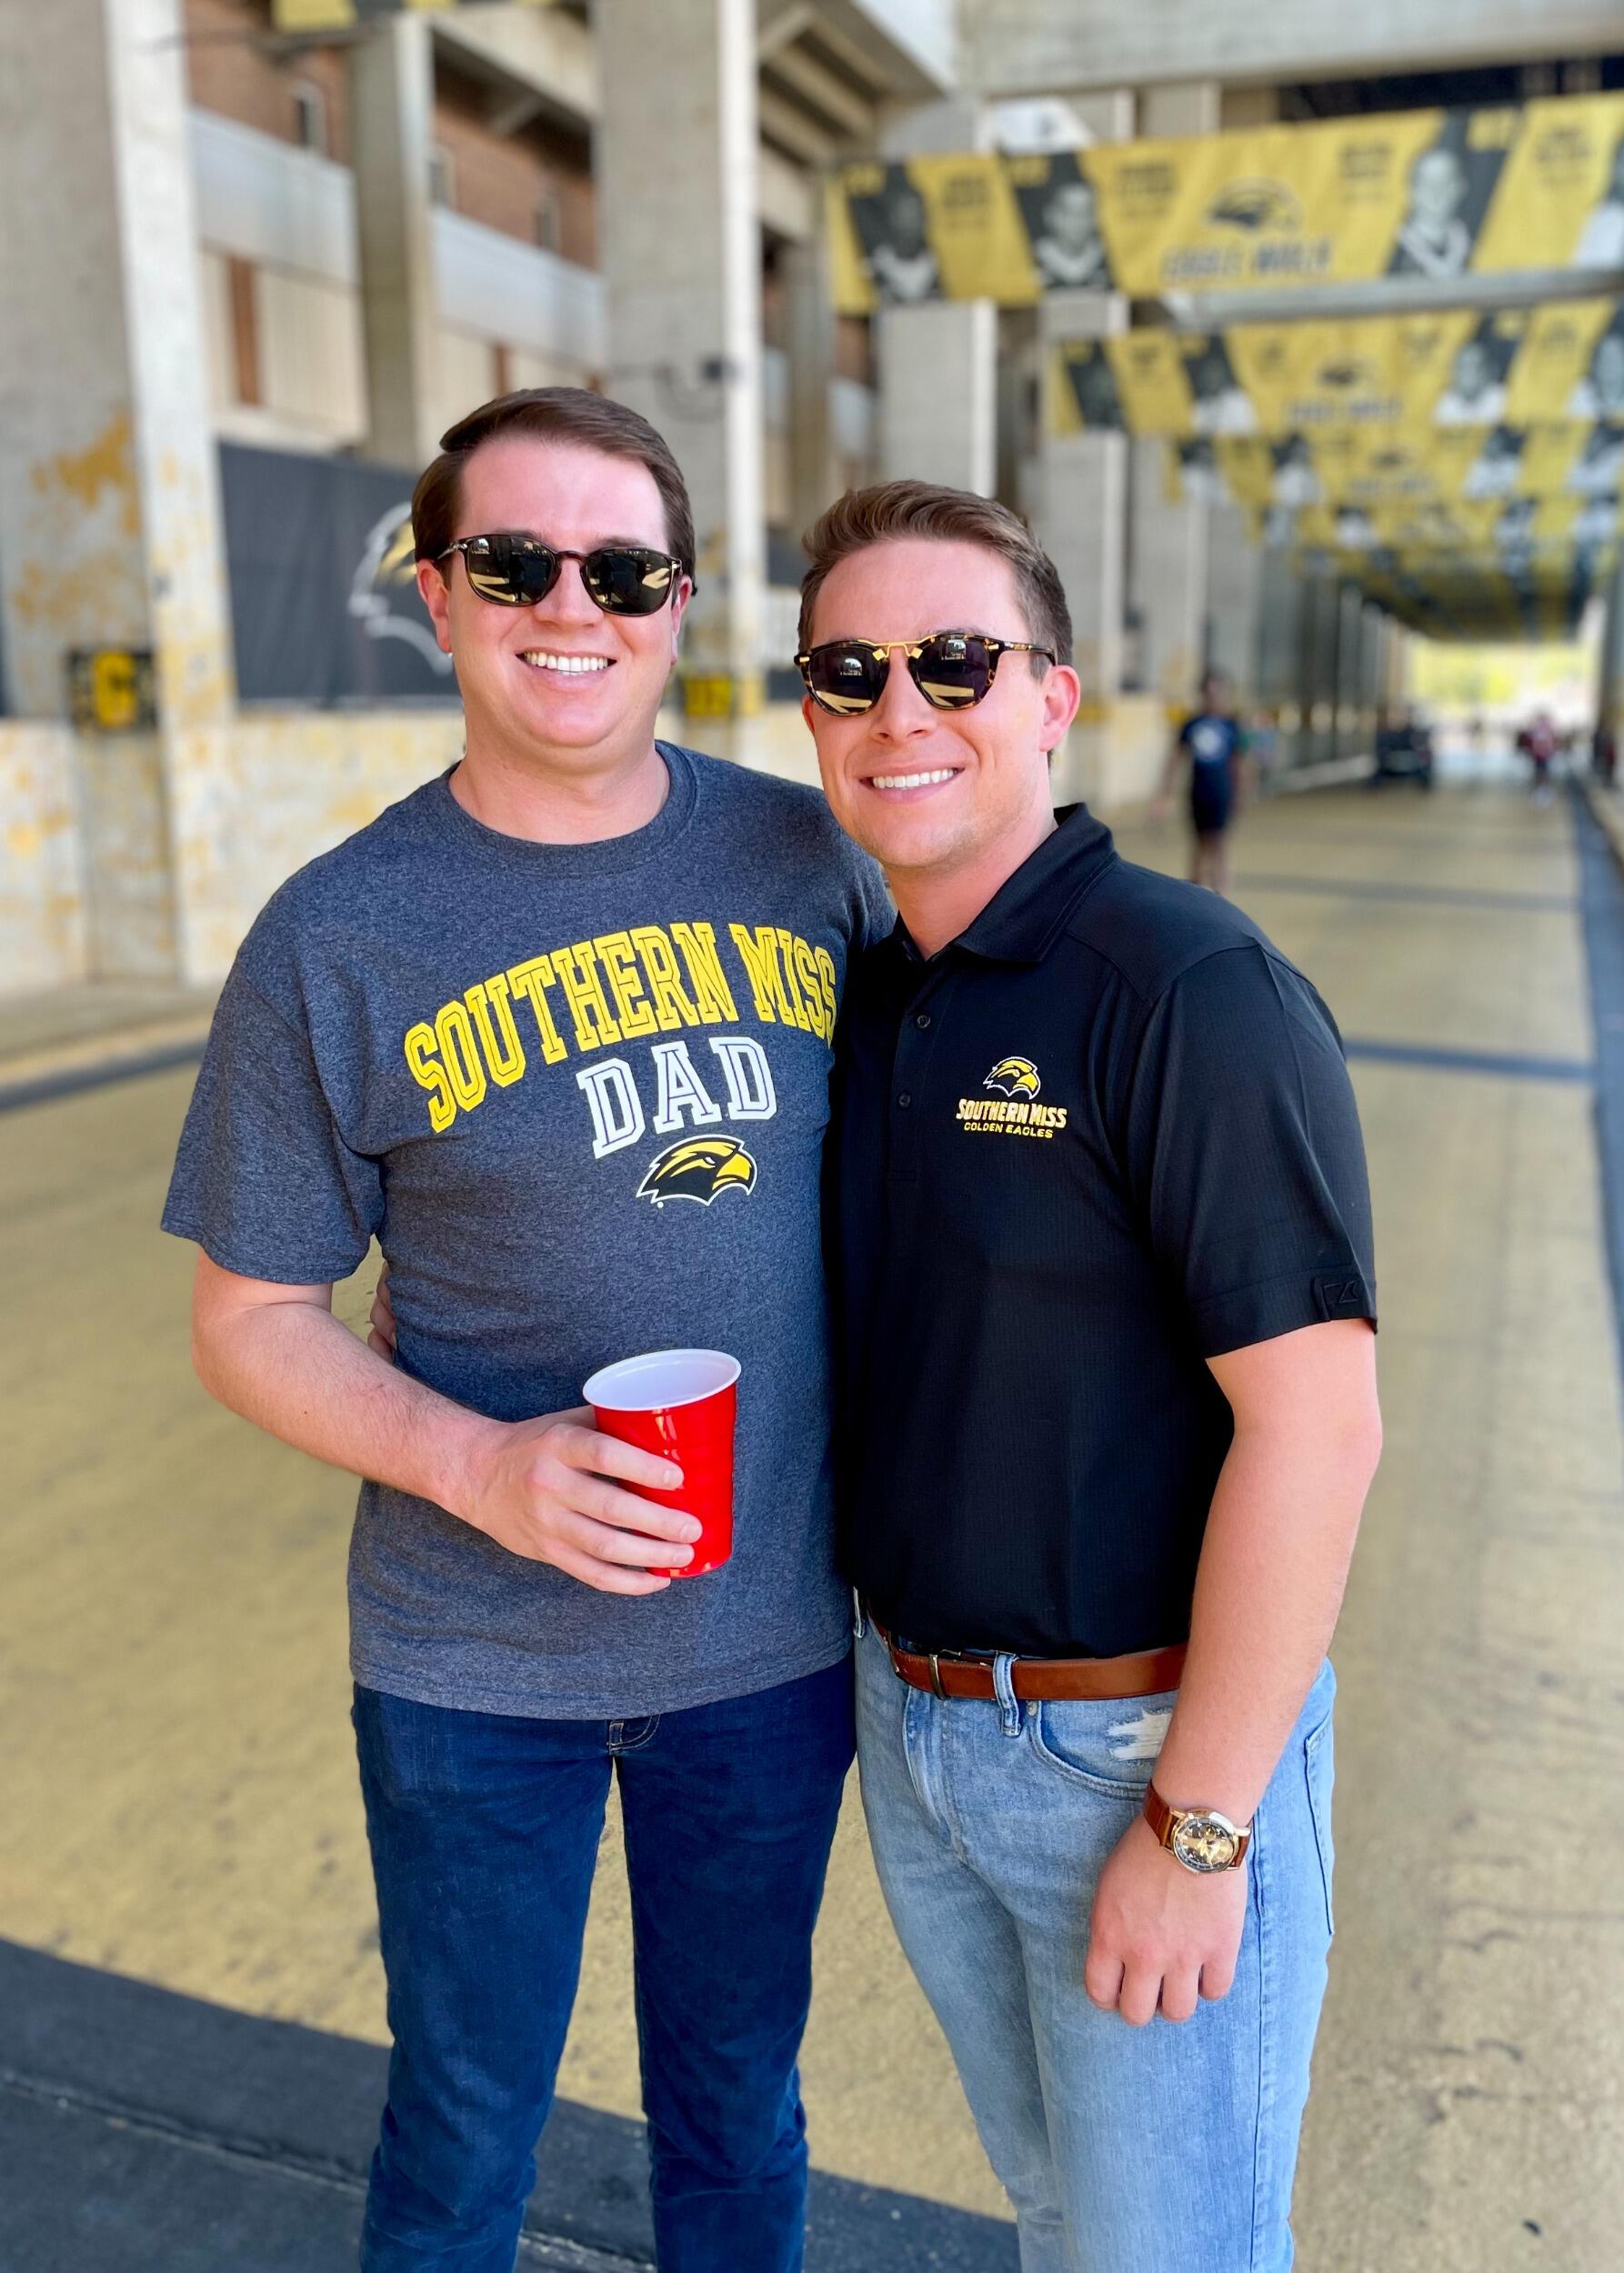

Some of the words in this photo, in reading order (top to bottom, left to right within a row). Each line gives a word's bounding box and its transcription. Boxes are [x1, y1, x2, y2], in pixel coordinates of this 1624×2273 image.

[405, 922, 739, 1133] SOUTHERN
[728, 923, 836, 1049] MISS
[576, 1036, 777, 1159] DAD
[956, 1098, 1028, 1125] SOUTHERN
[1028, 1103, 1068, 1129] MISS
[964, 1121, 1004, 1134] GOLDEN
[1005, 1124, 1054, 1139] EAGLES
